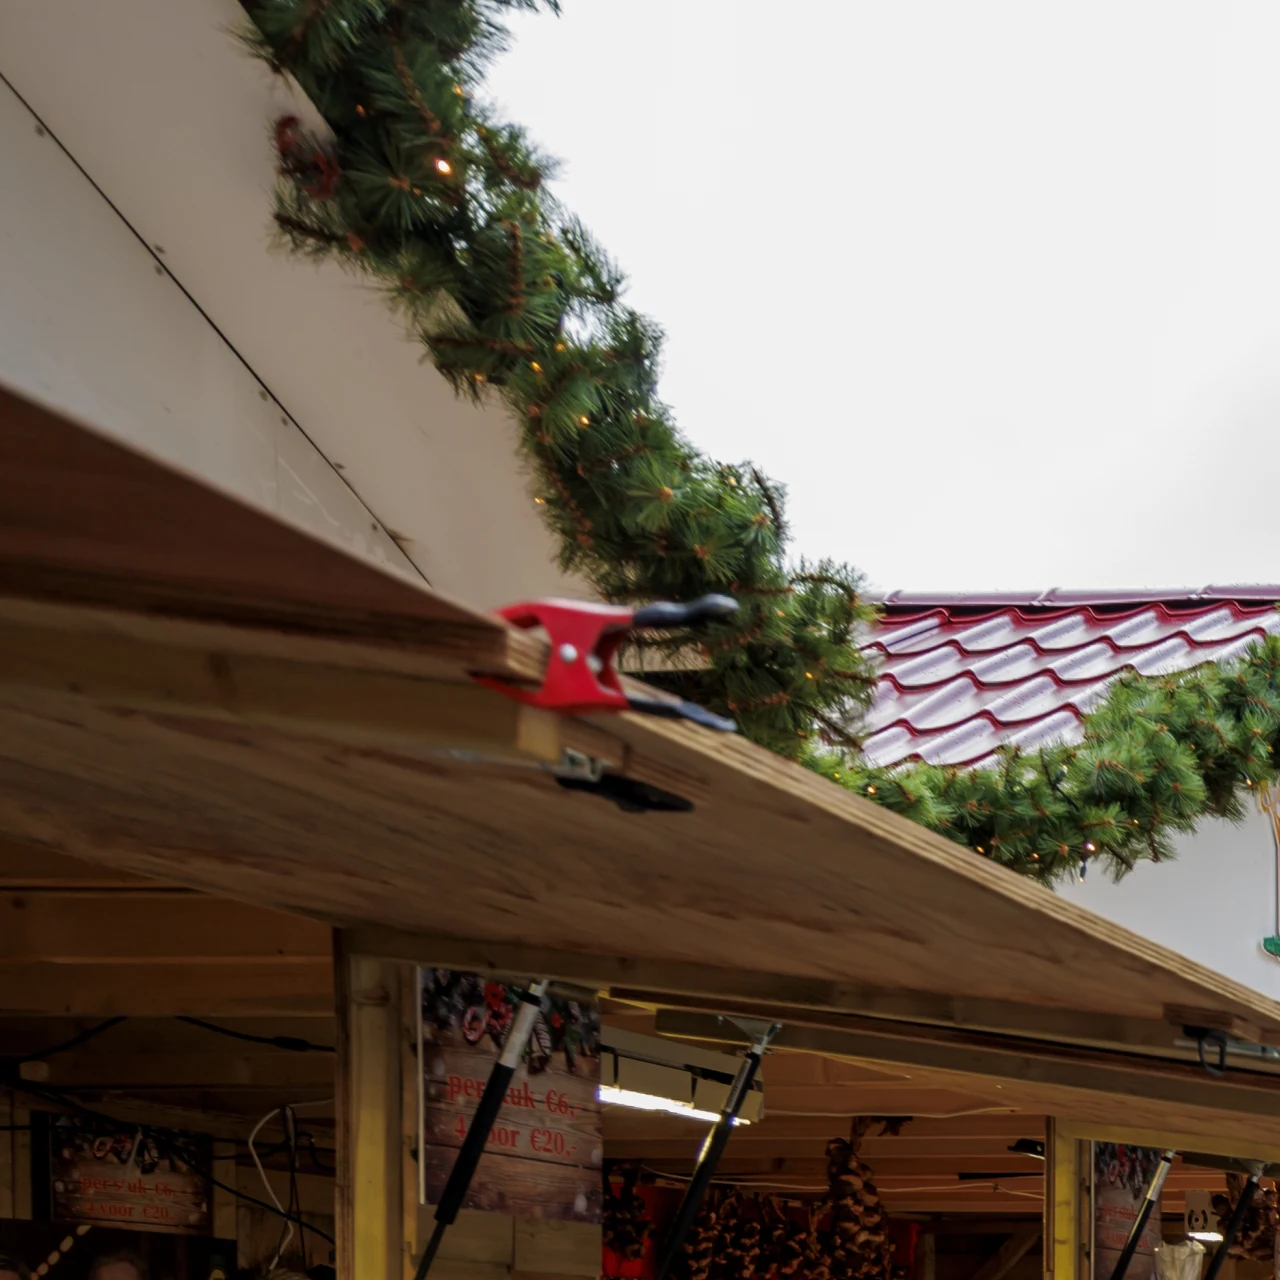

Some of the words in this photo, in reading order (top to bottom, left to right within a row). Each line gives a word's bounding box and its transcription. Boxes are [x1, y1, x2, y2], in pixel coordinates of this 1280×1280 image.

[449, 1076, 486, 1102] per
[546, 1090, 581, 1117] €6,-
[530, 1129, 578, 1158] €20,-
